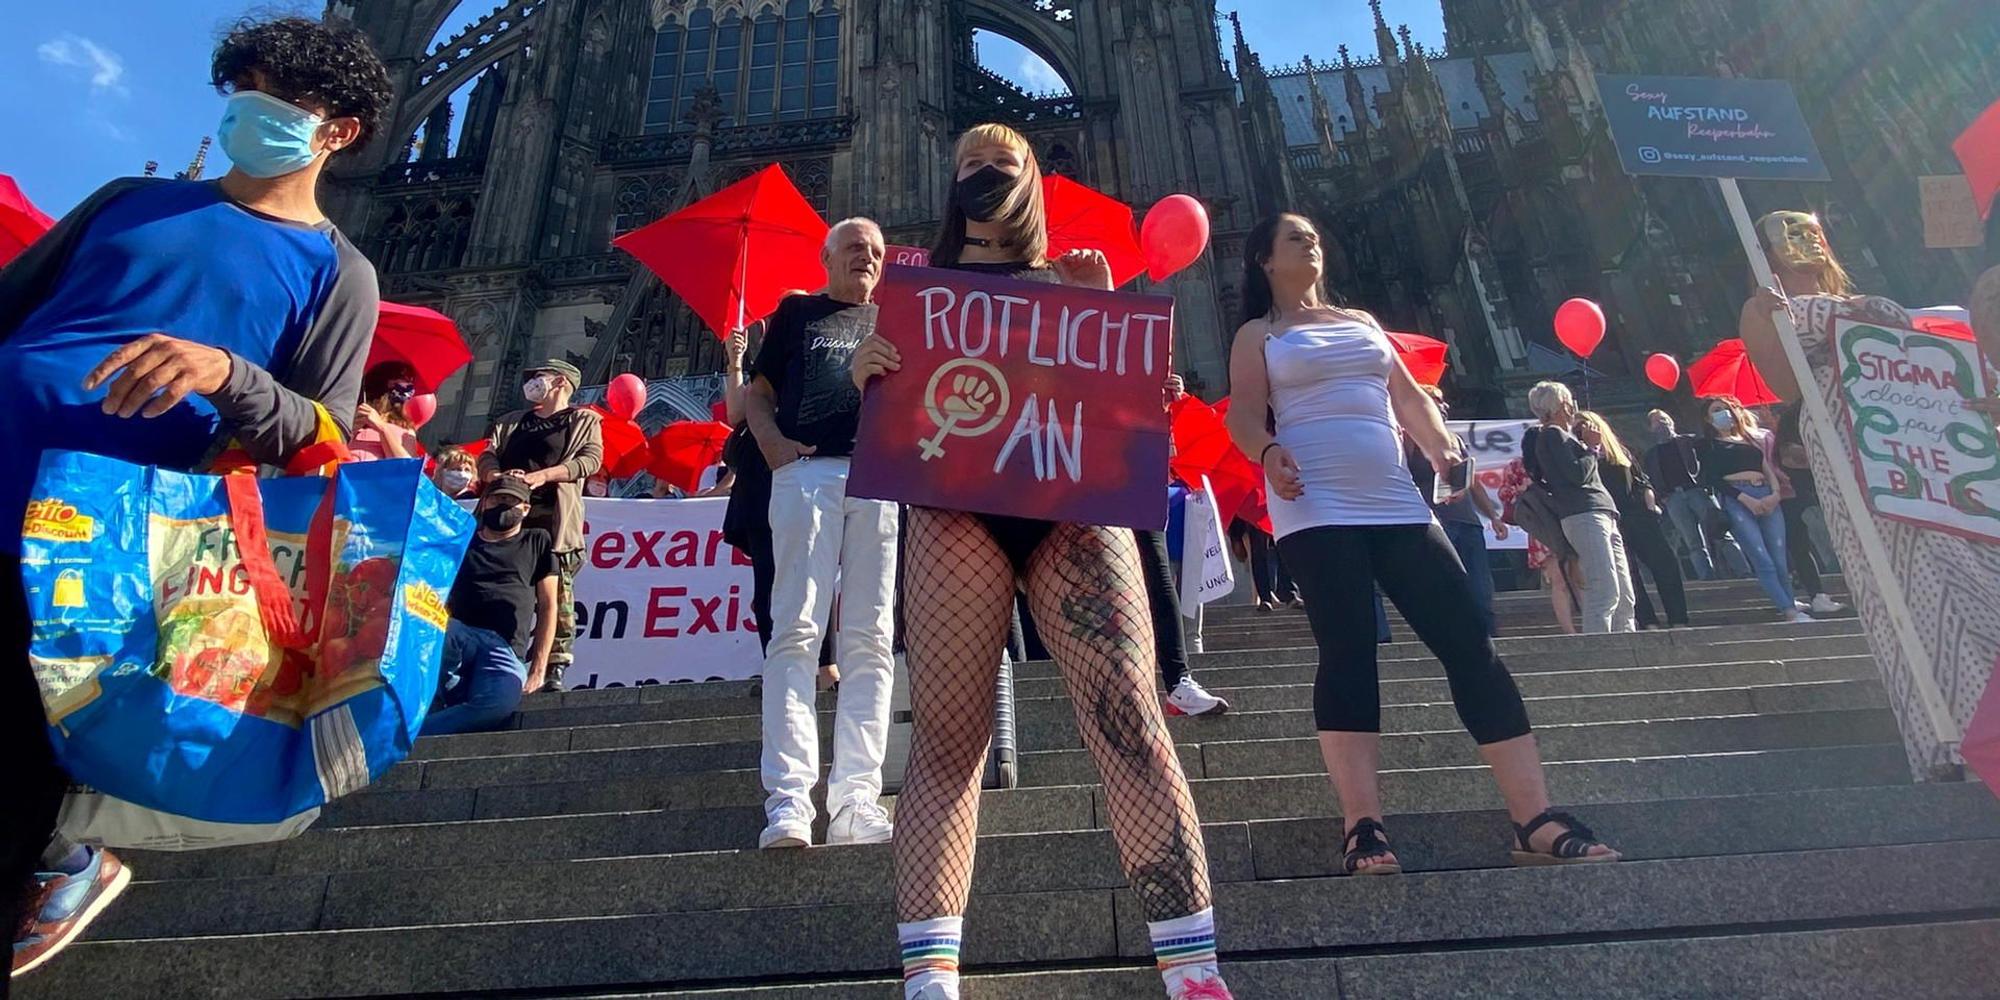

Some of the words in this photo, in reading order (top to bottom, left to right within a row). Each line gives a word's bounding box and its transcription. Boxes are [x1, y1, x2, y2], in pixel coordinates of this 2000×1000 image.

[1648, 105, 1749, 121] AUFSTAND
[1687, 121, 1776, 141] Reeperbahn
[915, 286, 1169, 376] ROTLICHT
[1858, 351, 1961, 390] STIGMA
[993, 392, 1083, 482] AN
[1898, 418, 1948, 442] pay
[1882, 438, 1950, 474] THE
[582, 519, 754, 570] exar
